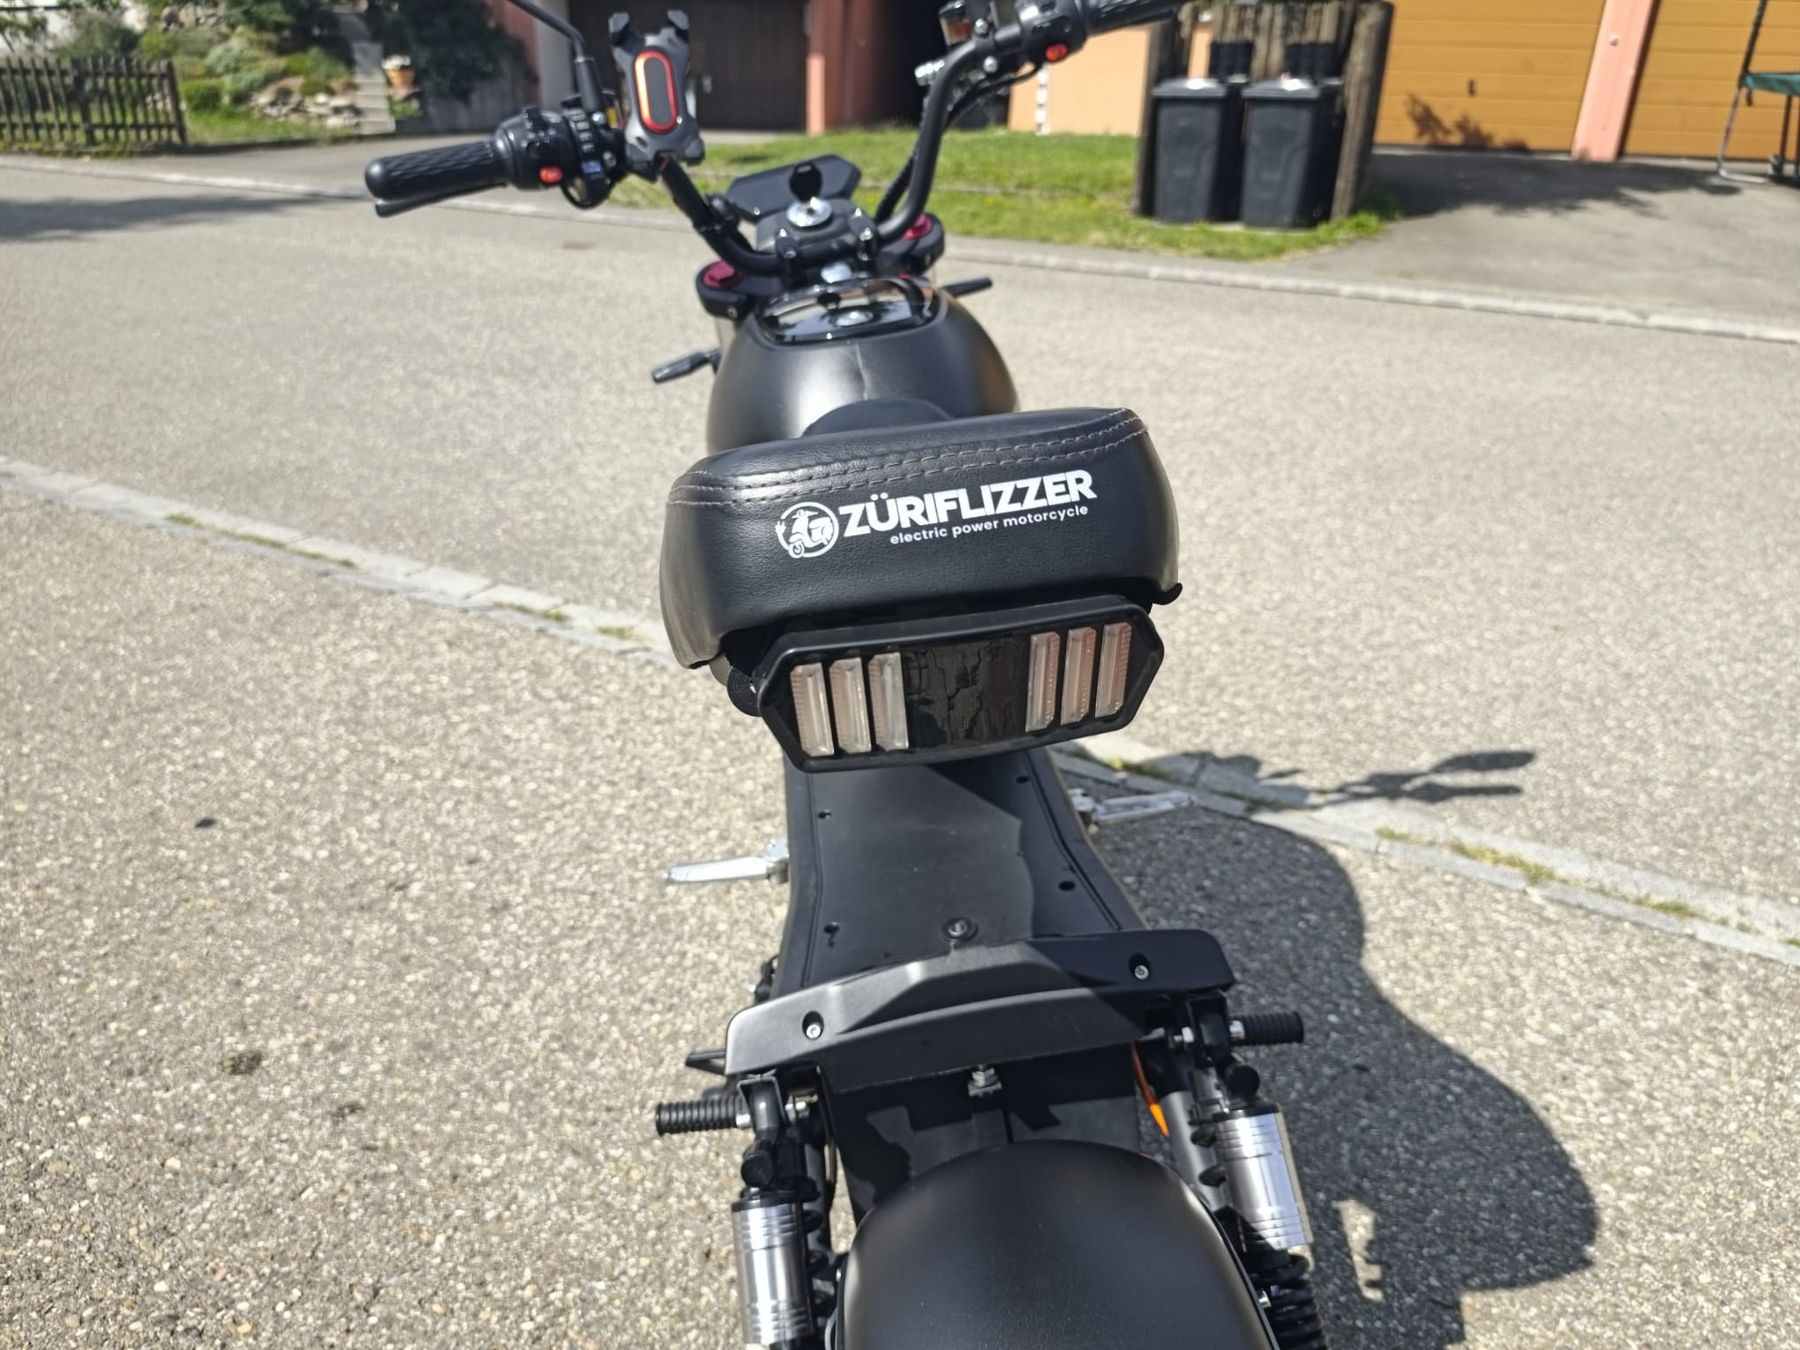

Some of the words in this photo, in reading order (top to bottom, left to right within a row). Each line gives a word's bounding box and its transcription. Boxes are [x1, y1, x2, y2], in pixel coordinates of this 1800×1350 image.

[838, 469, 1098, 537] ZÜRIFLIZZER
[890, 526, 948, 545] electric
[952, 519, 999, 538] power
[1003, 504, 1089, 527] motorcycle
